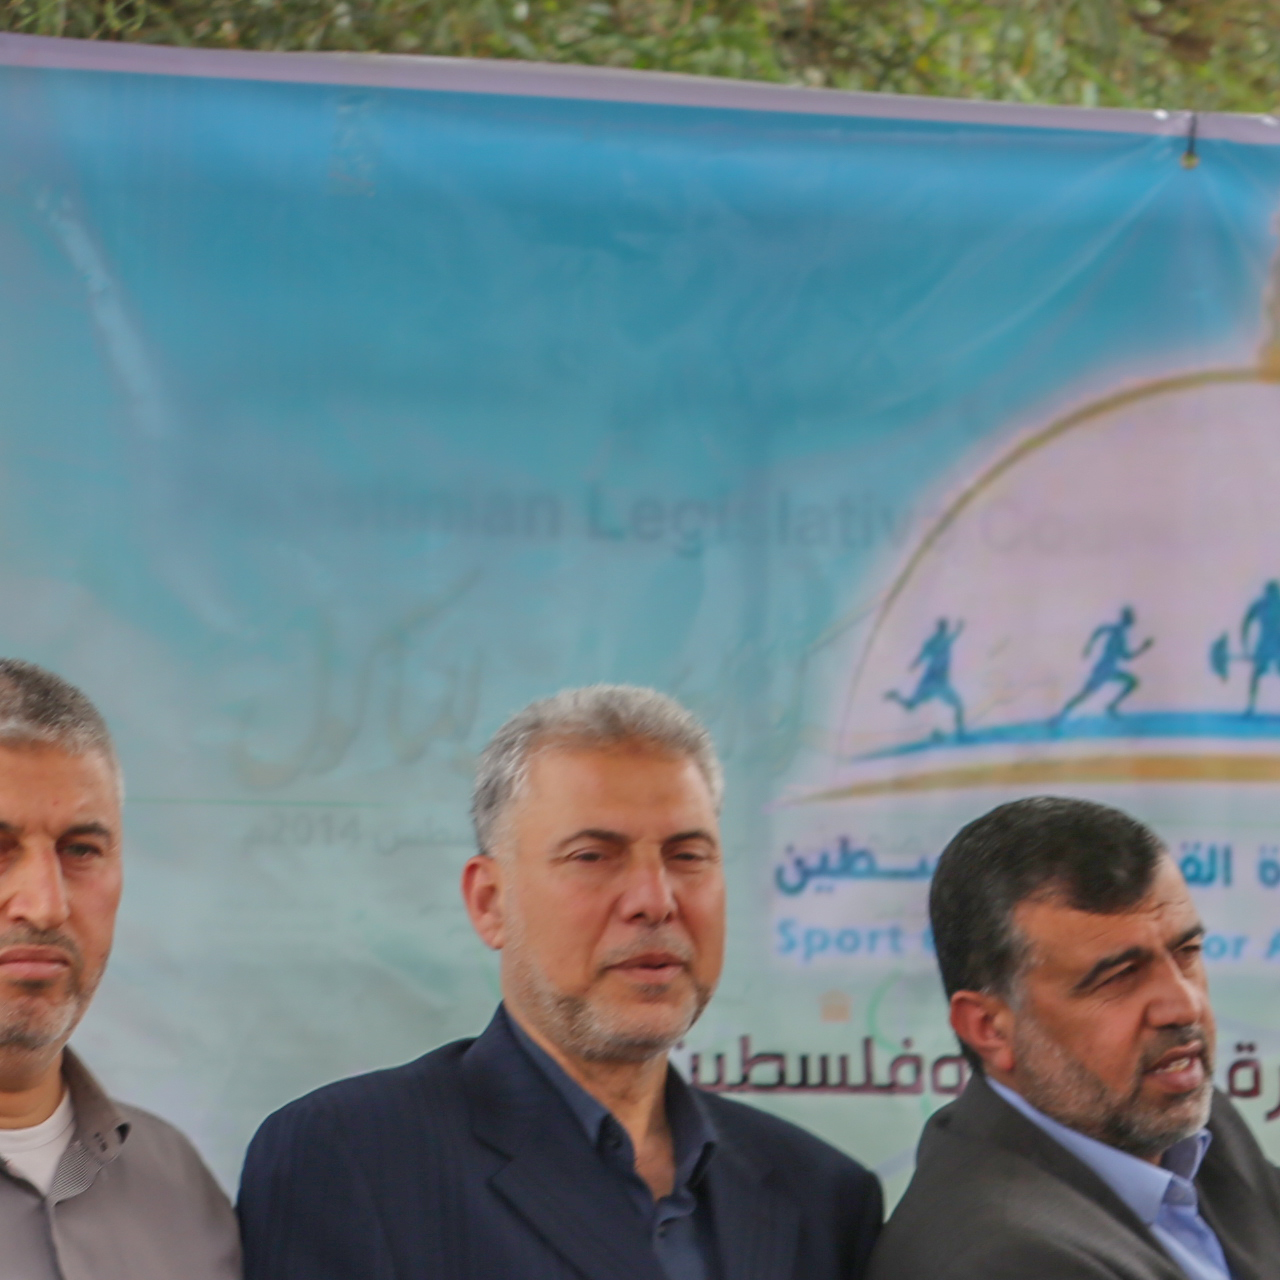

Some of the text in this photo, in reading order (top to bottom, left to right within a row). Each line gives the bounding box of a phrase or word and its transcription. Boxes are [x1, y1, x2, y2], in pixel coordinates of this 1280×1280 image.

[1179, 843, 1233, 888] الق
[777, 917, 904, 963] Sport
[1200, 932, 1248, 960] or
